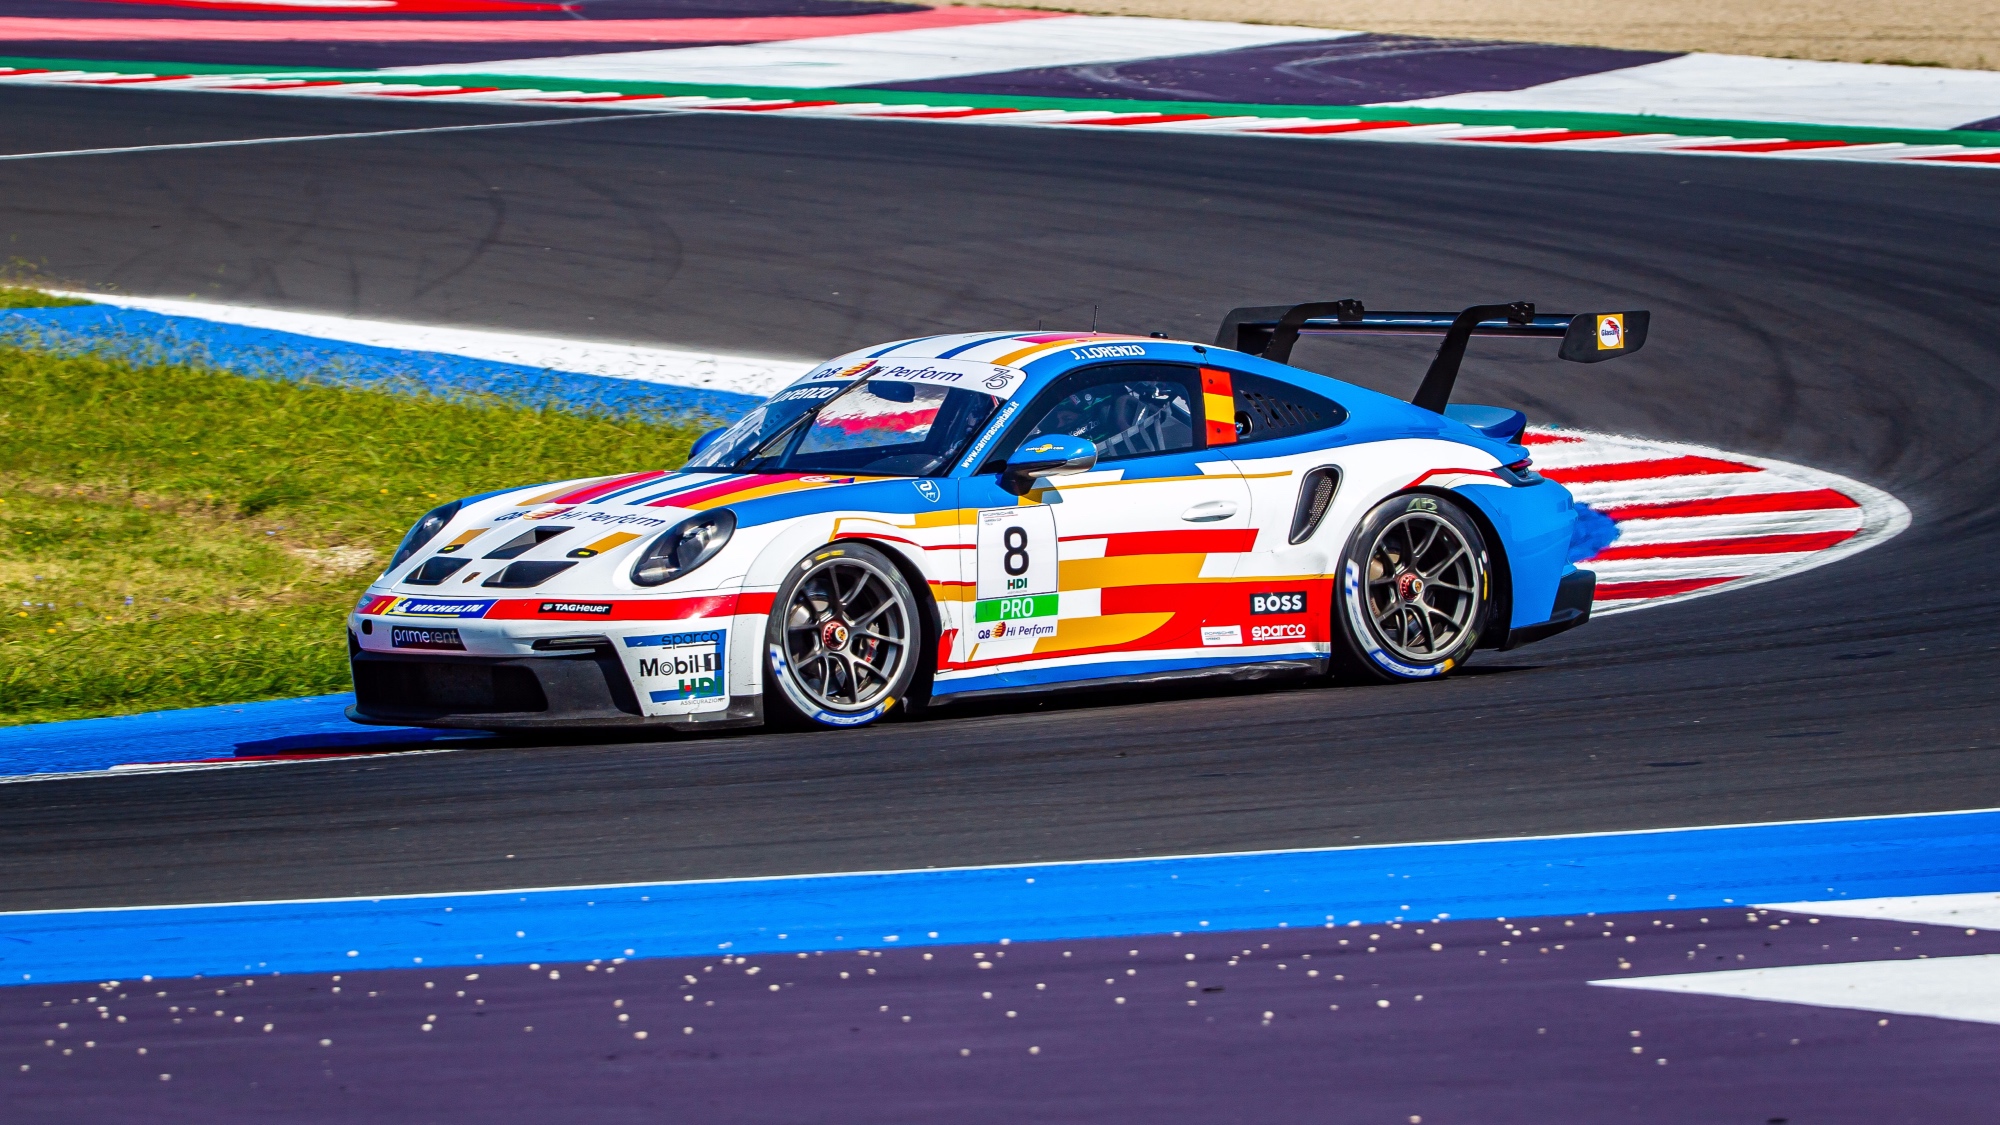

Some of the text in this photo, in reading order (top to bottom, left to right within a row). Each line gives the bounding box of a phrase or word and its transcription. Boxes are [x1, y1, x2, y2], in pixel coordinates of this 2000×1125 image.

[1084, 345, 1146, 359] LORENZO
[812, 367, 843, 380] Q8
[882, 366, 963, 381] Perform
[961, 401, 1020, 468] www.carreracupitalia.it
[577, 512, 666, 527] Perform
[1004, 526, 1029, 576] 8
[1007, 578, 1028, 590] HDI
[410, 603, 485, 613] MICHELIN
[1000, 598, 1034, 619] PRO
[1254, 595, 1302, 612] BOSS
[393, 629, 459, 645] primerent
[978, 624, 1054, 639] Q8 Hi Perform
[1252, 624, 1306, 641] sparco
[661, 632, 720, 649] sparco
[640, 655, 699, 677] Mobil
[679, 676, 723, 696] HDI
